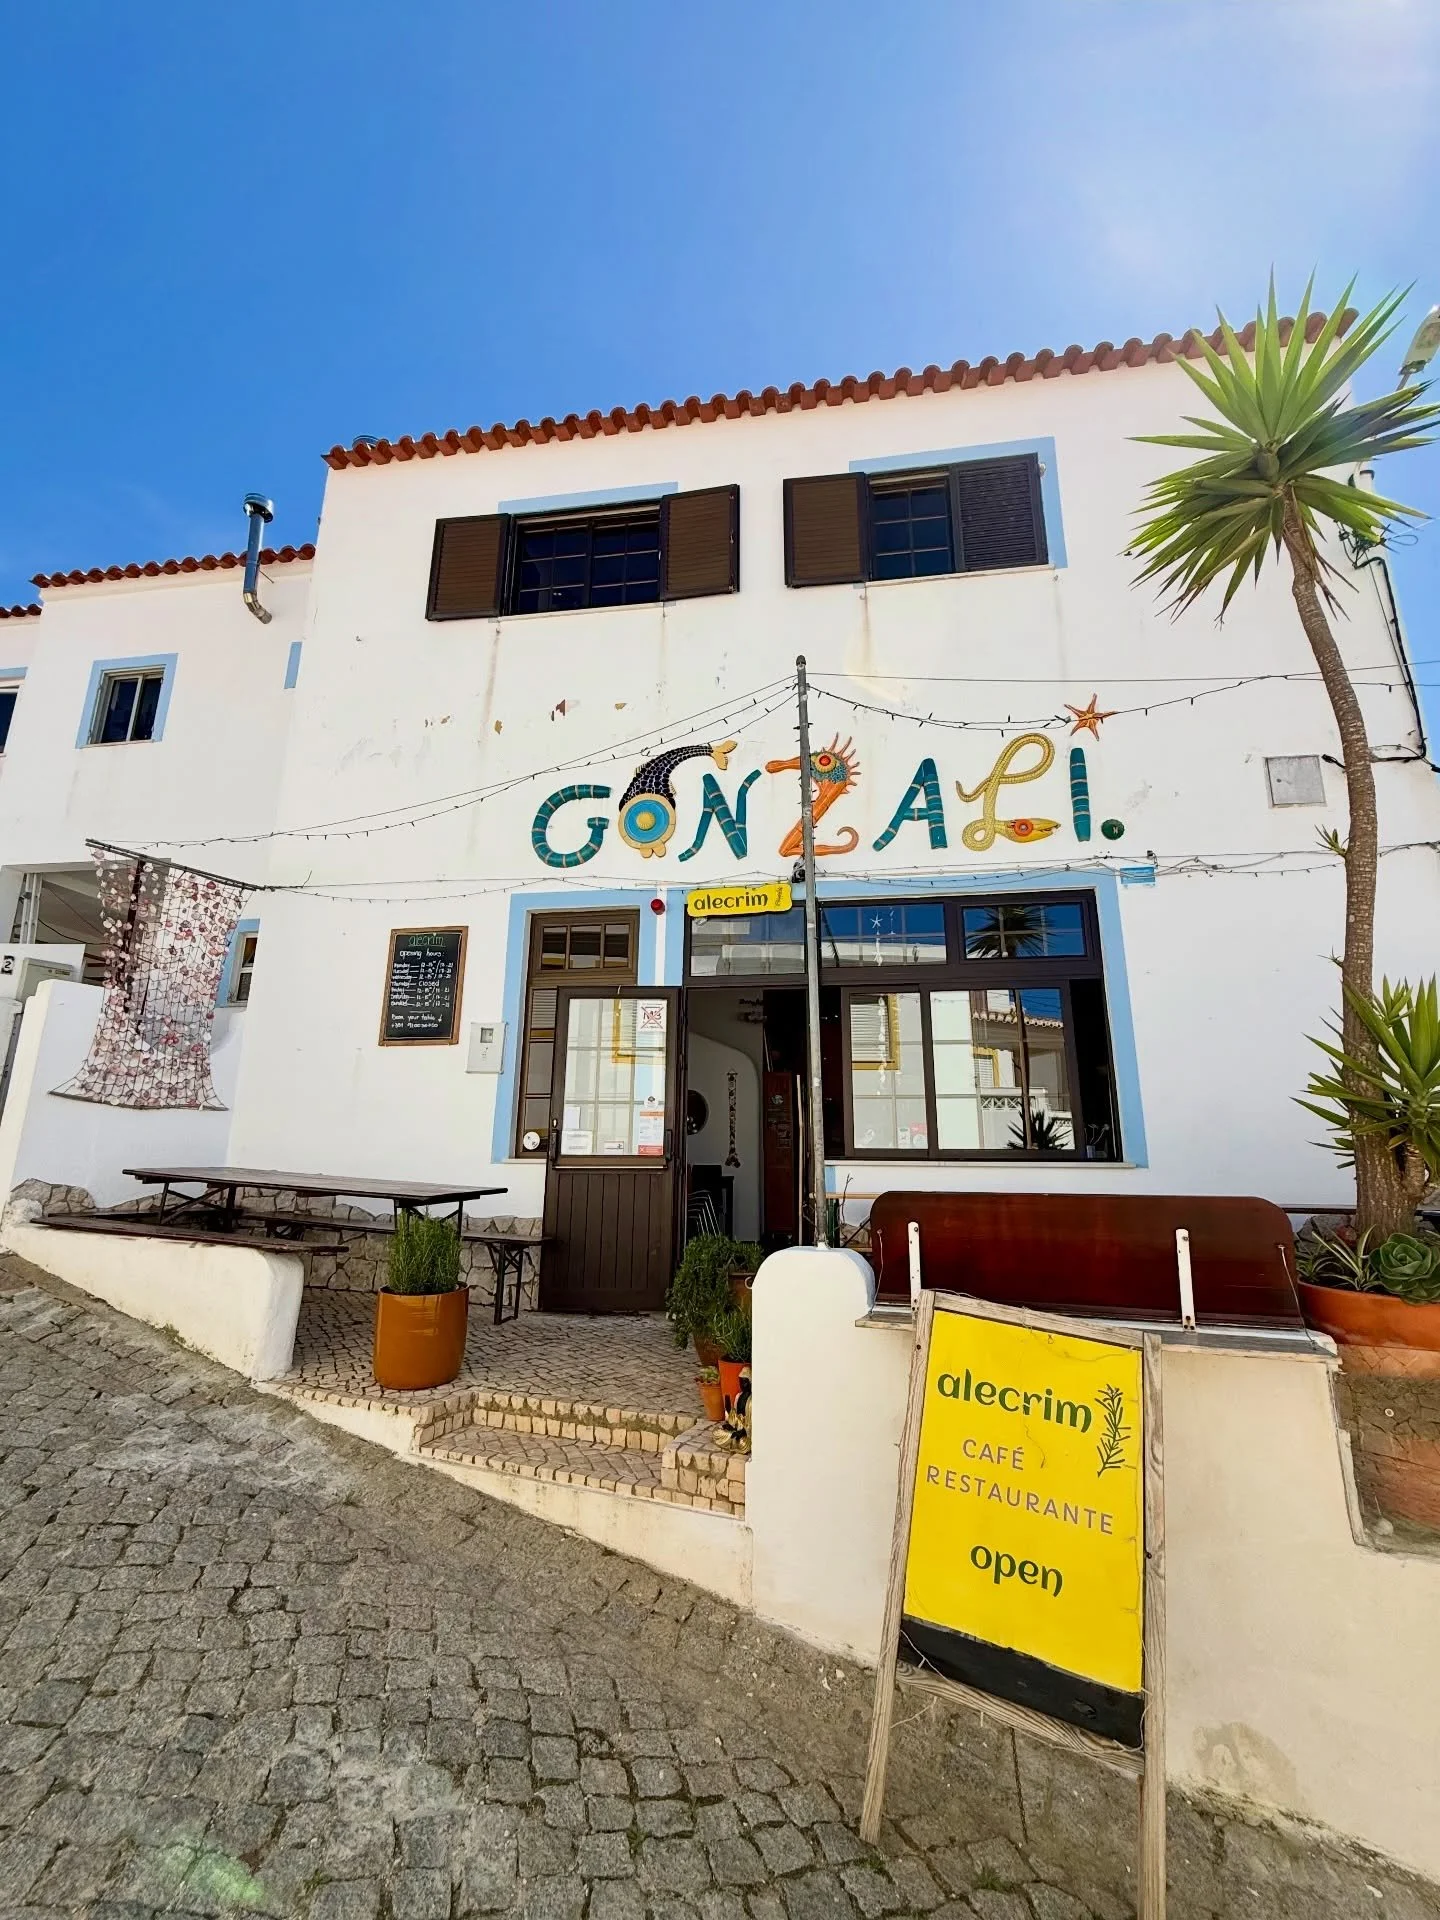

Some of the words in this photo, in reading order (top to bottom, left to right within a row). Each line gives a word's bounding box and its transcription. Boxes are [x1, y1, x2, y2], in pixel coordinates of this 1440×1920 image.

[693, 891, 769, 911] alecrim
[937, 1368, 1092, 1433] alecrim
[962, 1438, 1025, 1471] CAFÉ
[926, 1465, 1114, 1535] RESTAURANTE
[970, 1545, 1063, 1598] open
